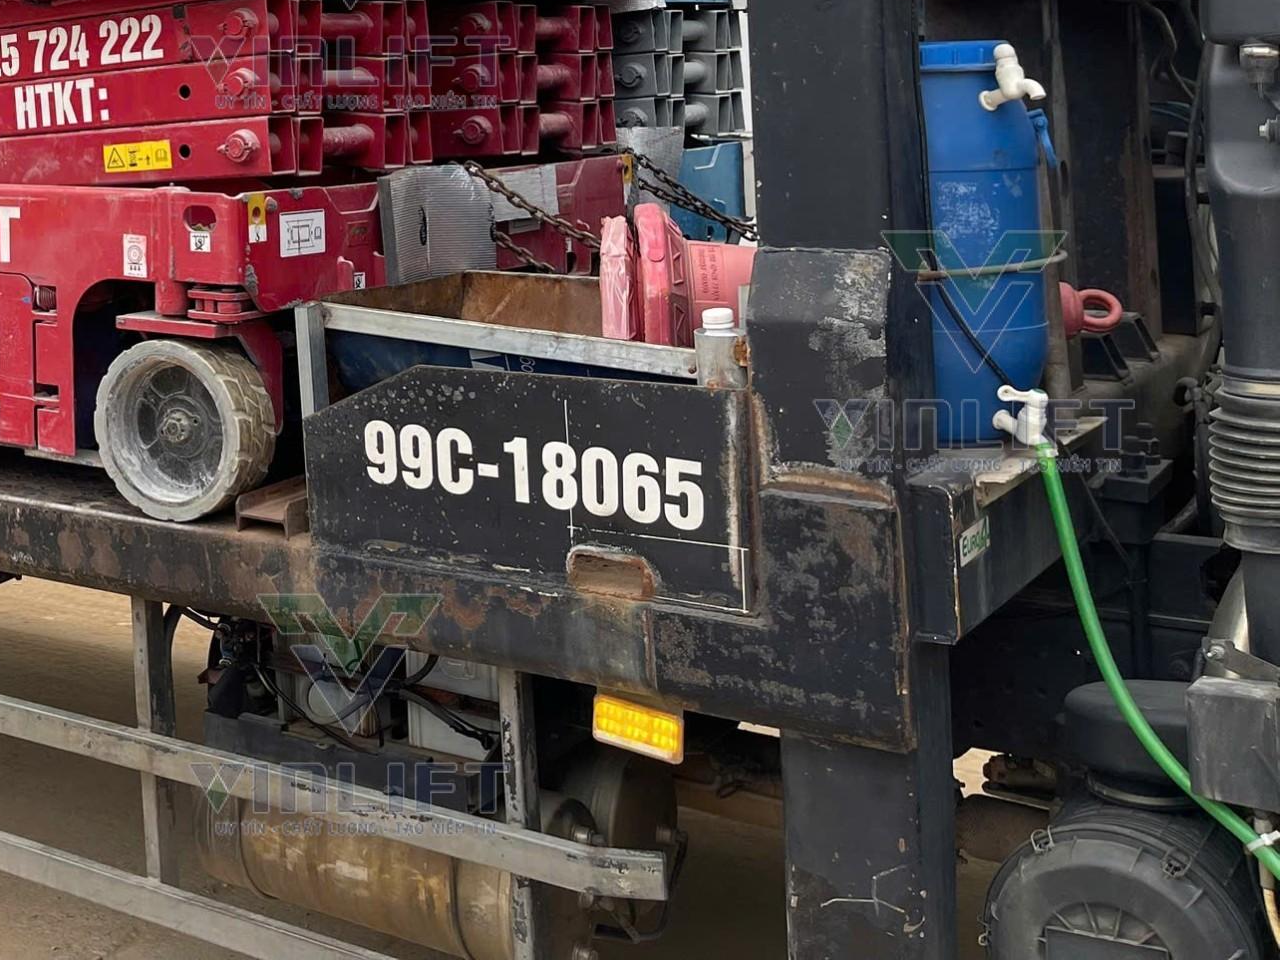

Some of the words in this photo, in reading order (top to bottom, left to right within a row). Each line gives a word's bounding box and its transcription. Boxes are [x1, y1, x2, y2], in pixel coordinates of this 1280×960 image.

[28, 24, 90, 74] 724
[98, 14, 164, 66] 222
[14, 78, 110, 131] HTKT:
[363, 419, 705, 531] 99C-18065
